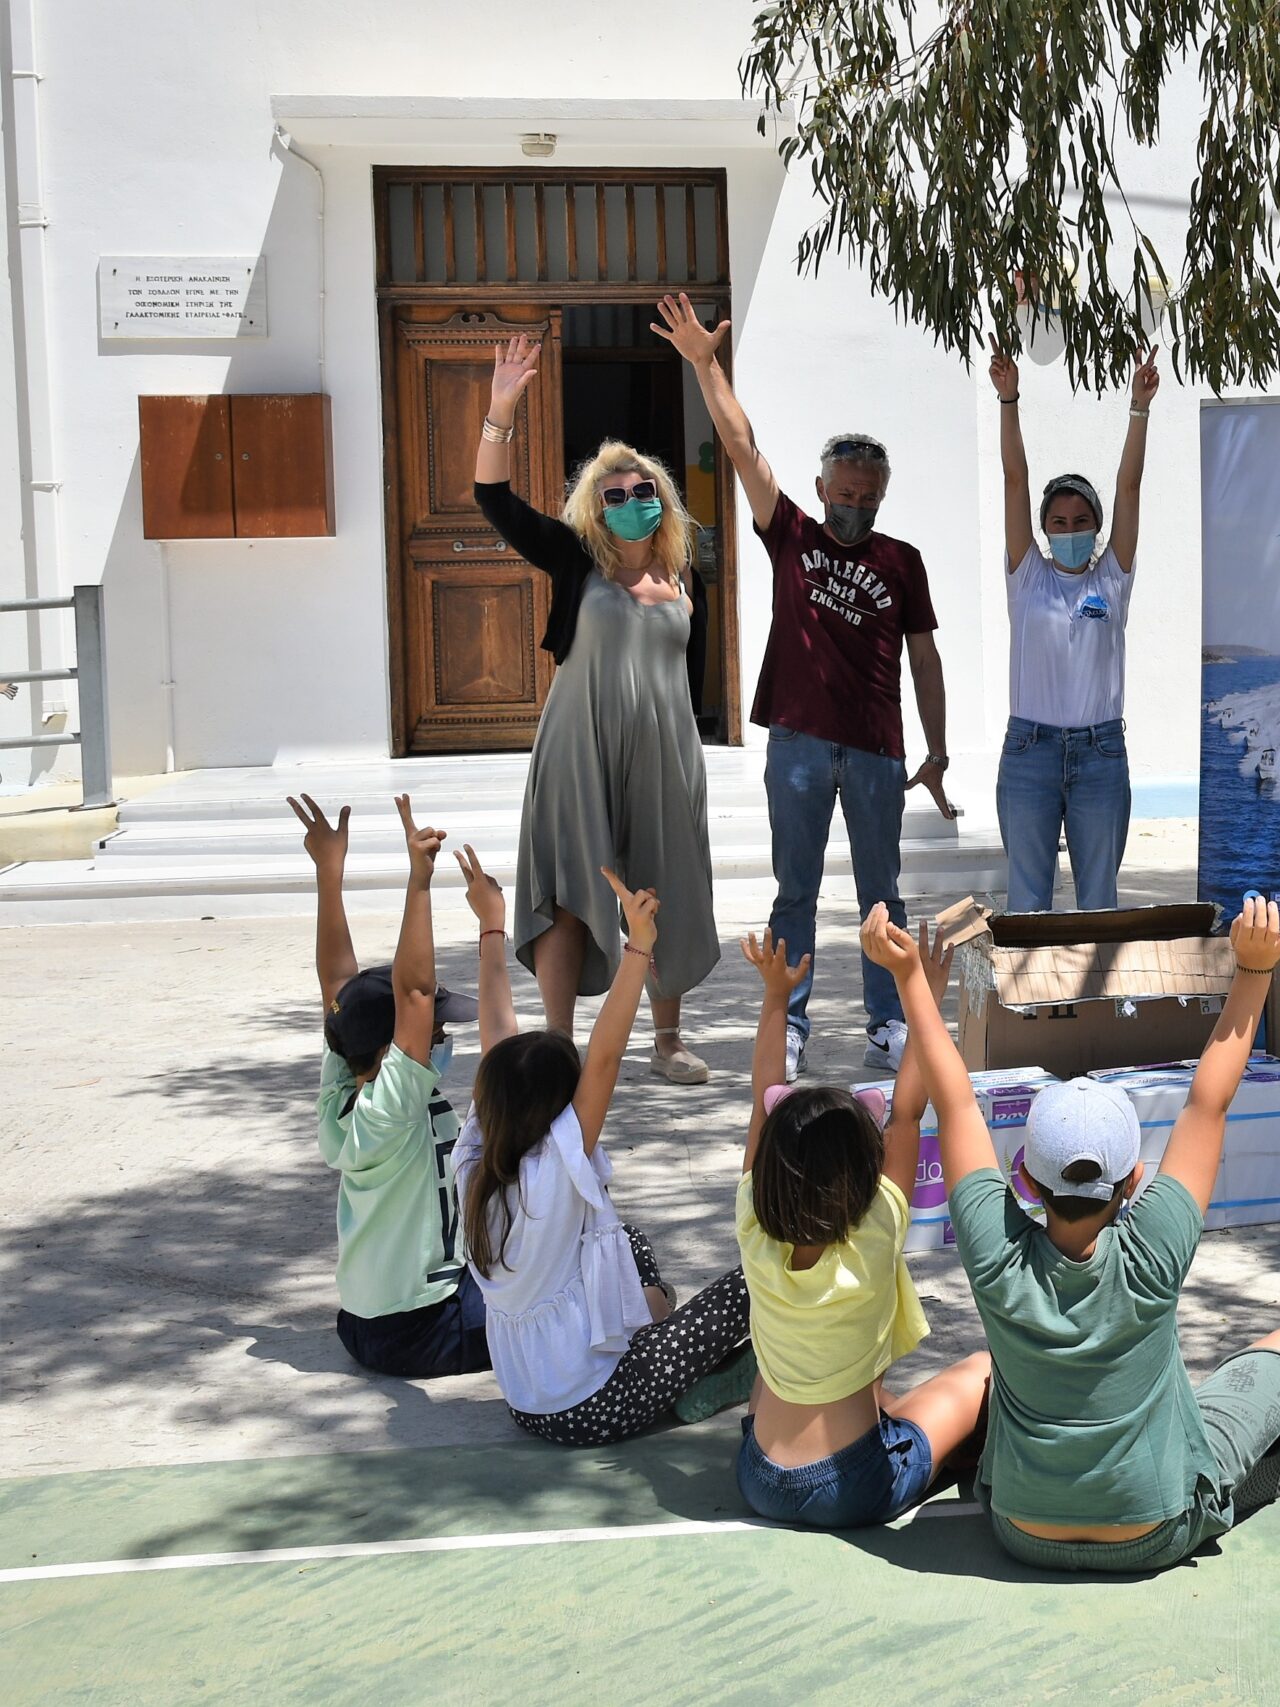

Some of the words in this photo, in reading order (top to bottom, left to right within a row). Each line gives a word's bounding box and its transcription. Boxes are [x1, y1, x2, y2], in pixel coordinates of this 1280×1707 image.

[826, 576, 857, 603] 1914
[833, 559, 893, 610] LEGEND
[810, 588, 863, 626] ENGLAND
